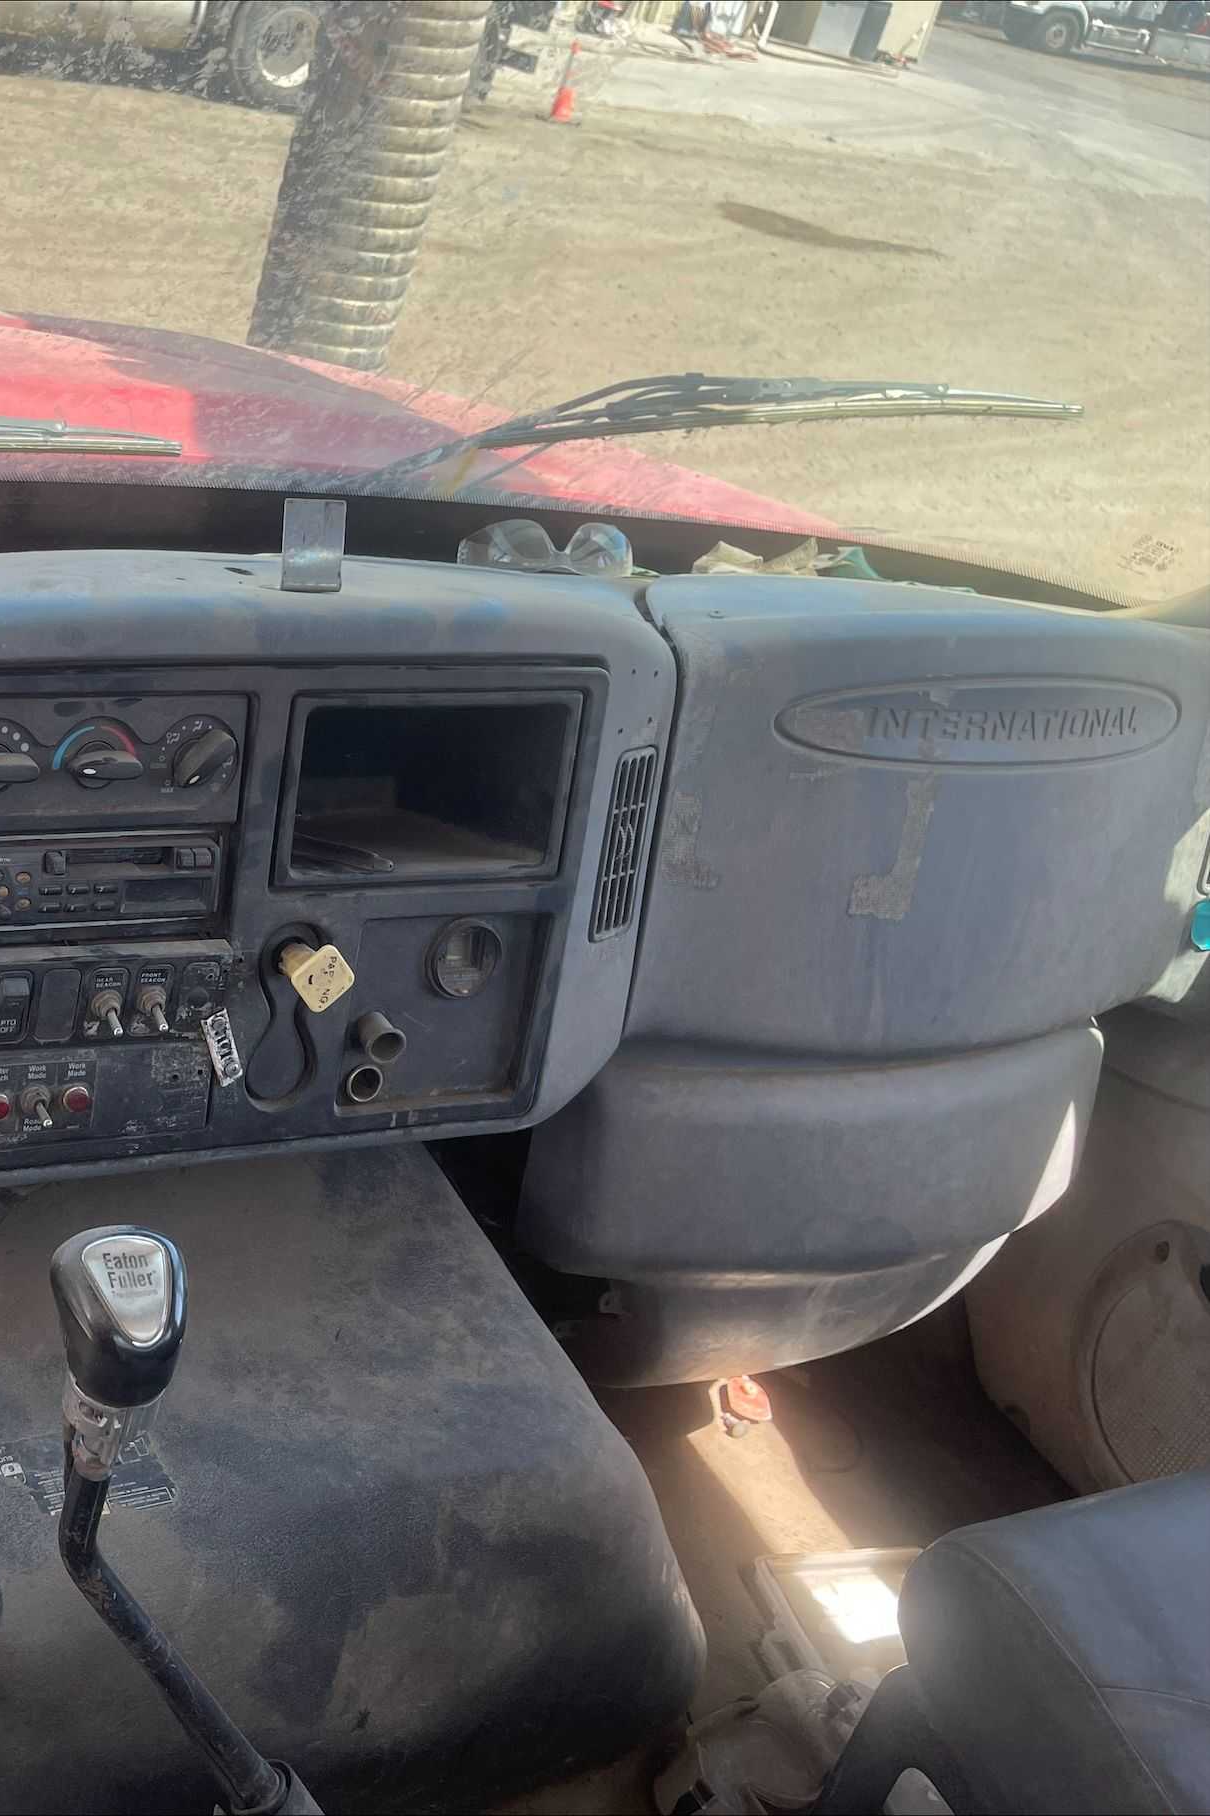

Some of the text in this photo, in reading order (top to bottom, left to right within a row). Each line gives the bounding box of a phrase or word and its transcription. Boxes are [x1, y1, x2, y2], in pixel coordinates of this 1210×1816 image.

[866, 704, 1138, 743] INTERNATIONAL
[102, 1251, 149, 1270] Eaton
[107, 1271, 153, 1289] Fuller
